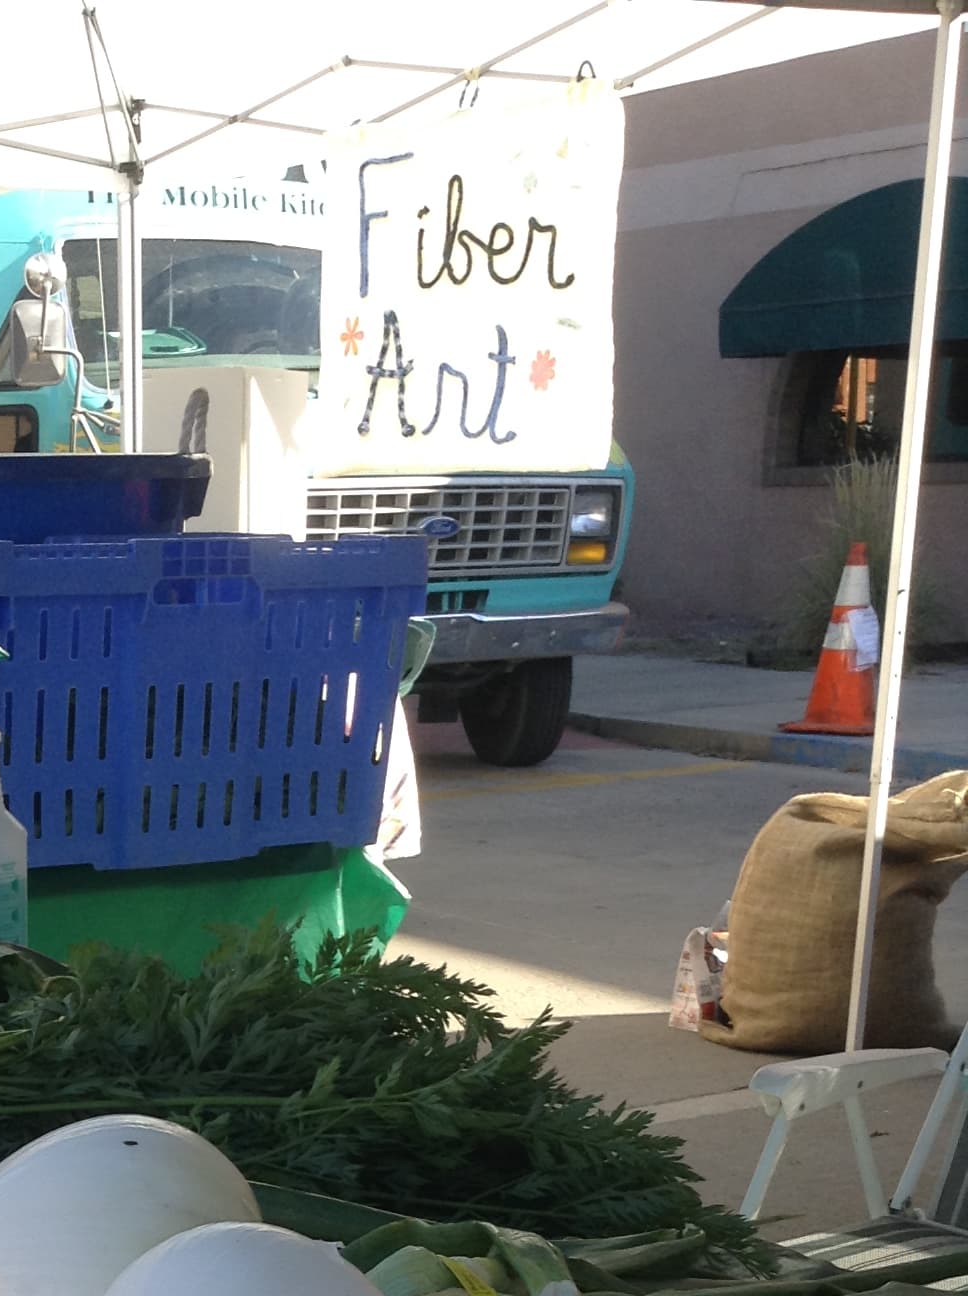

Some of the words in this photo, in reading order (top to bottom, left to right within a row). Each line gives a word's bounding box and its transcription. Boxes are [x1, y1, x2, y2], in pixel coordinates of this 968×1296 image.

[162, 185, 268, 211] Mobile
[359, 151, 576, 298] Fiber
[357, 309, 518, 445] Art
